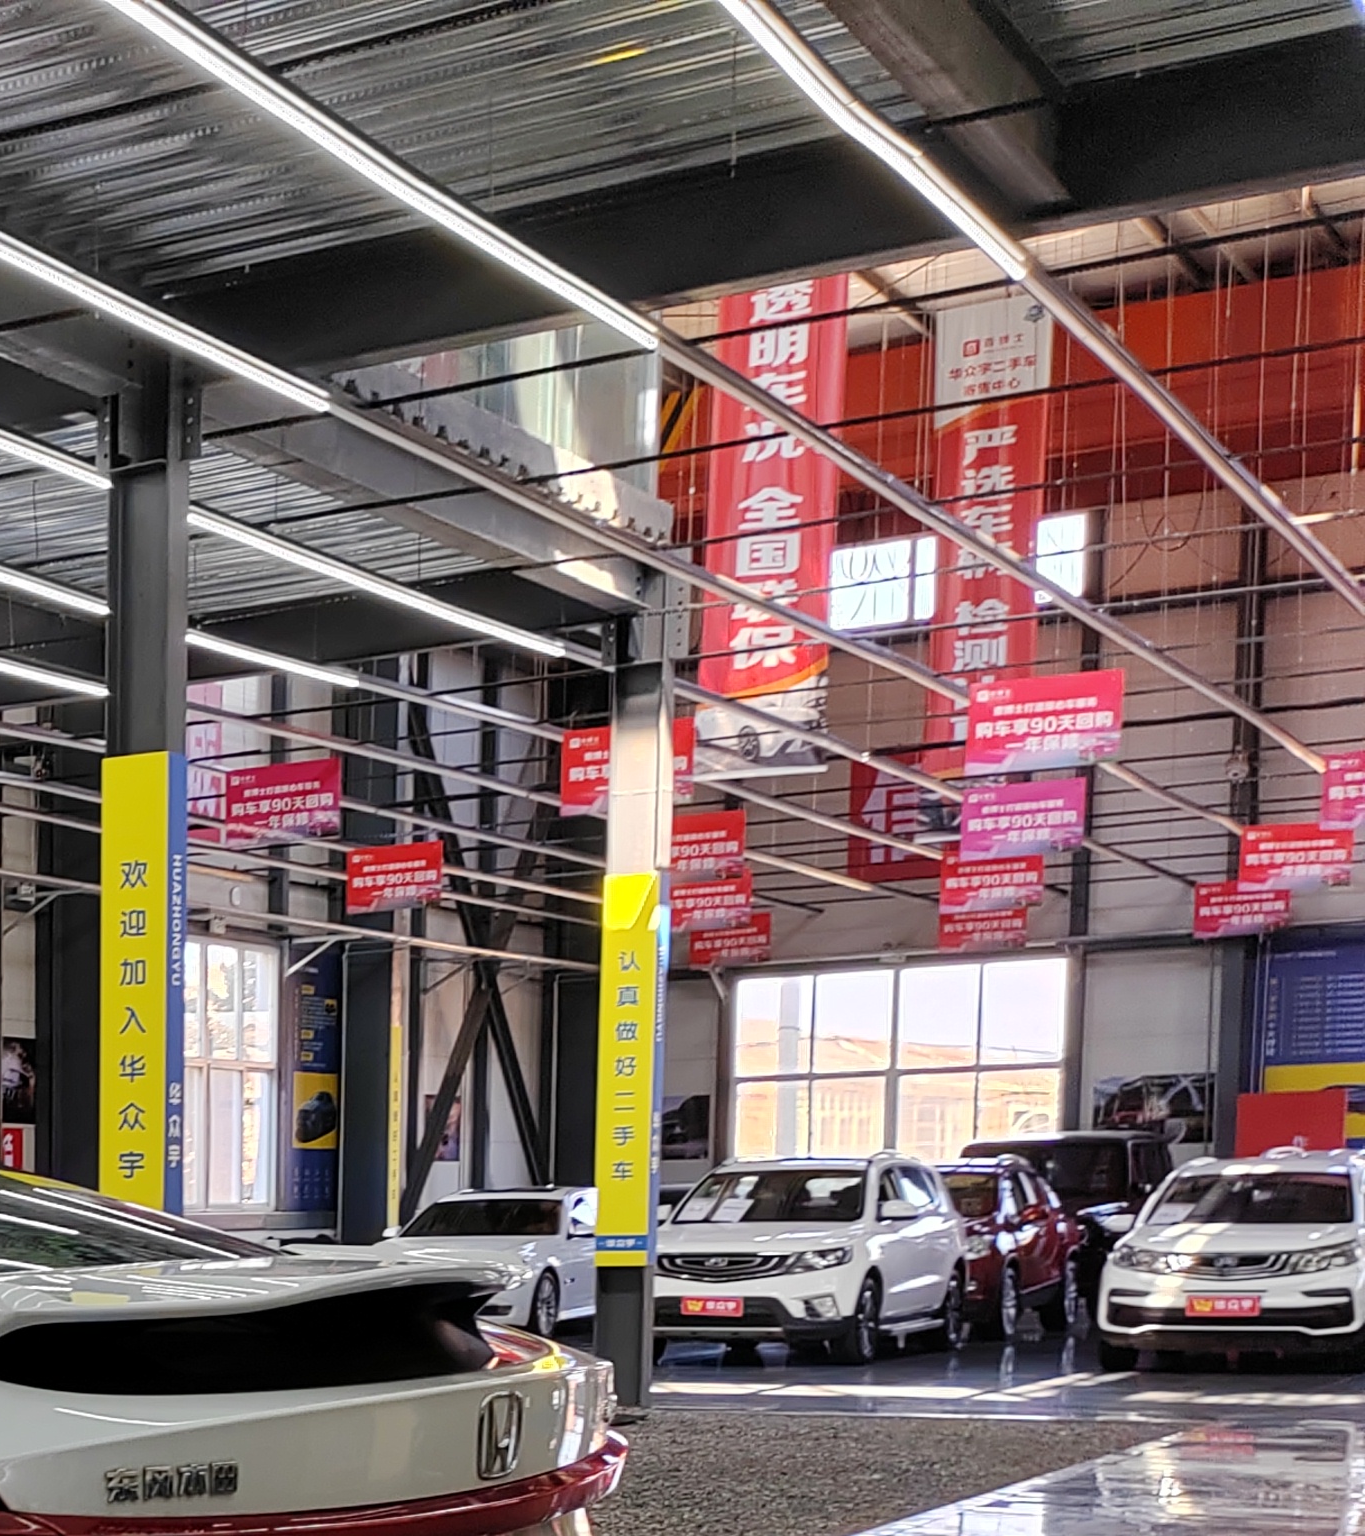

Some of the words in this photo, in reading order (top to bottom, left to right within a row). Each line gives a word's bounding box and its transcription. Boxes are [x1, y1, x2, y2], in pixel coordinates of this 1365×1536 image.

[975, 711, 1114, 739] 购车享90天回购
[230, 792, 334, 817] 购车享90天回购
[968, 810, 1077, 832] 购车享90天回购
[352, 870, 438, 888] 购车享90天回购
[671, 893, 746, 909] 车享90天回购
[170, 853, 183, 987] HUAZHONGYU
[117, 858, 150, 1179] 欢迎加入华众宇
[610, 951, 642, 1182] 认真做好二手车
[167, 1081, 182, 1169] 华众宇
[105, 1460, 239, 1504] 东风本田
